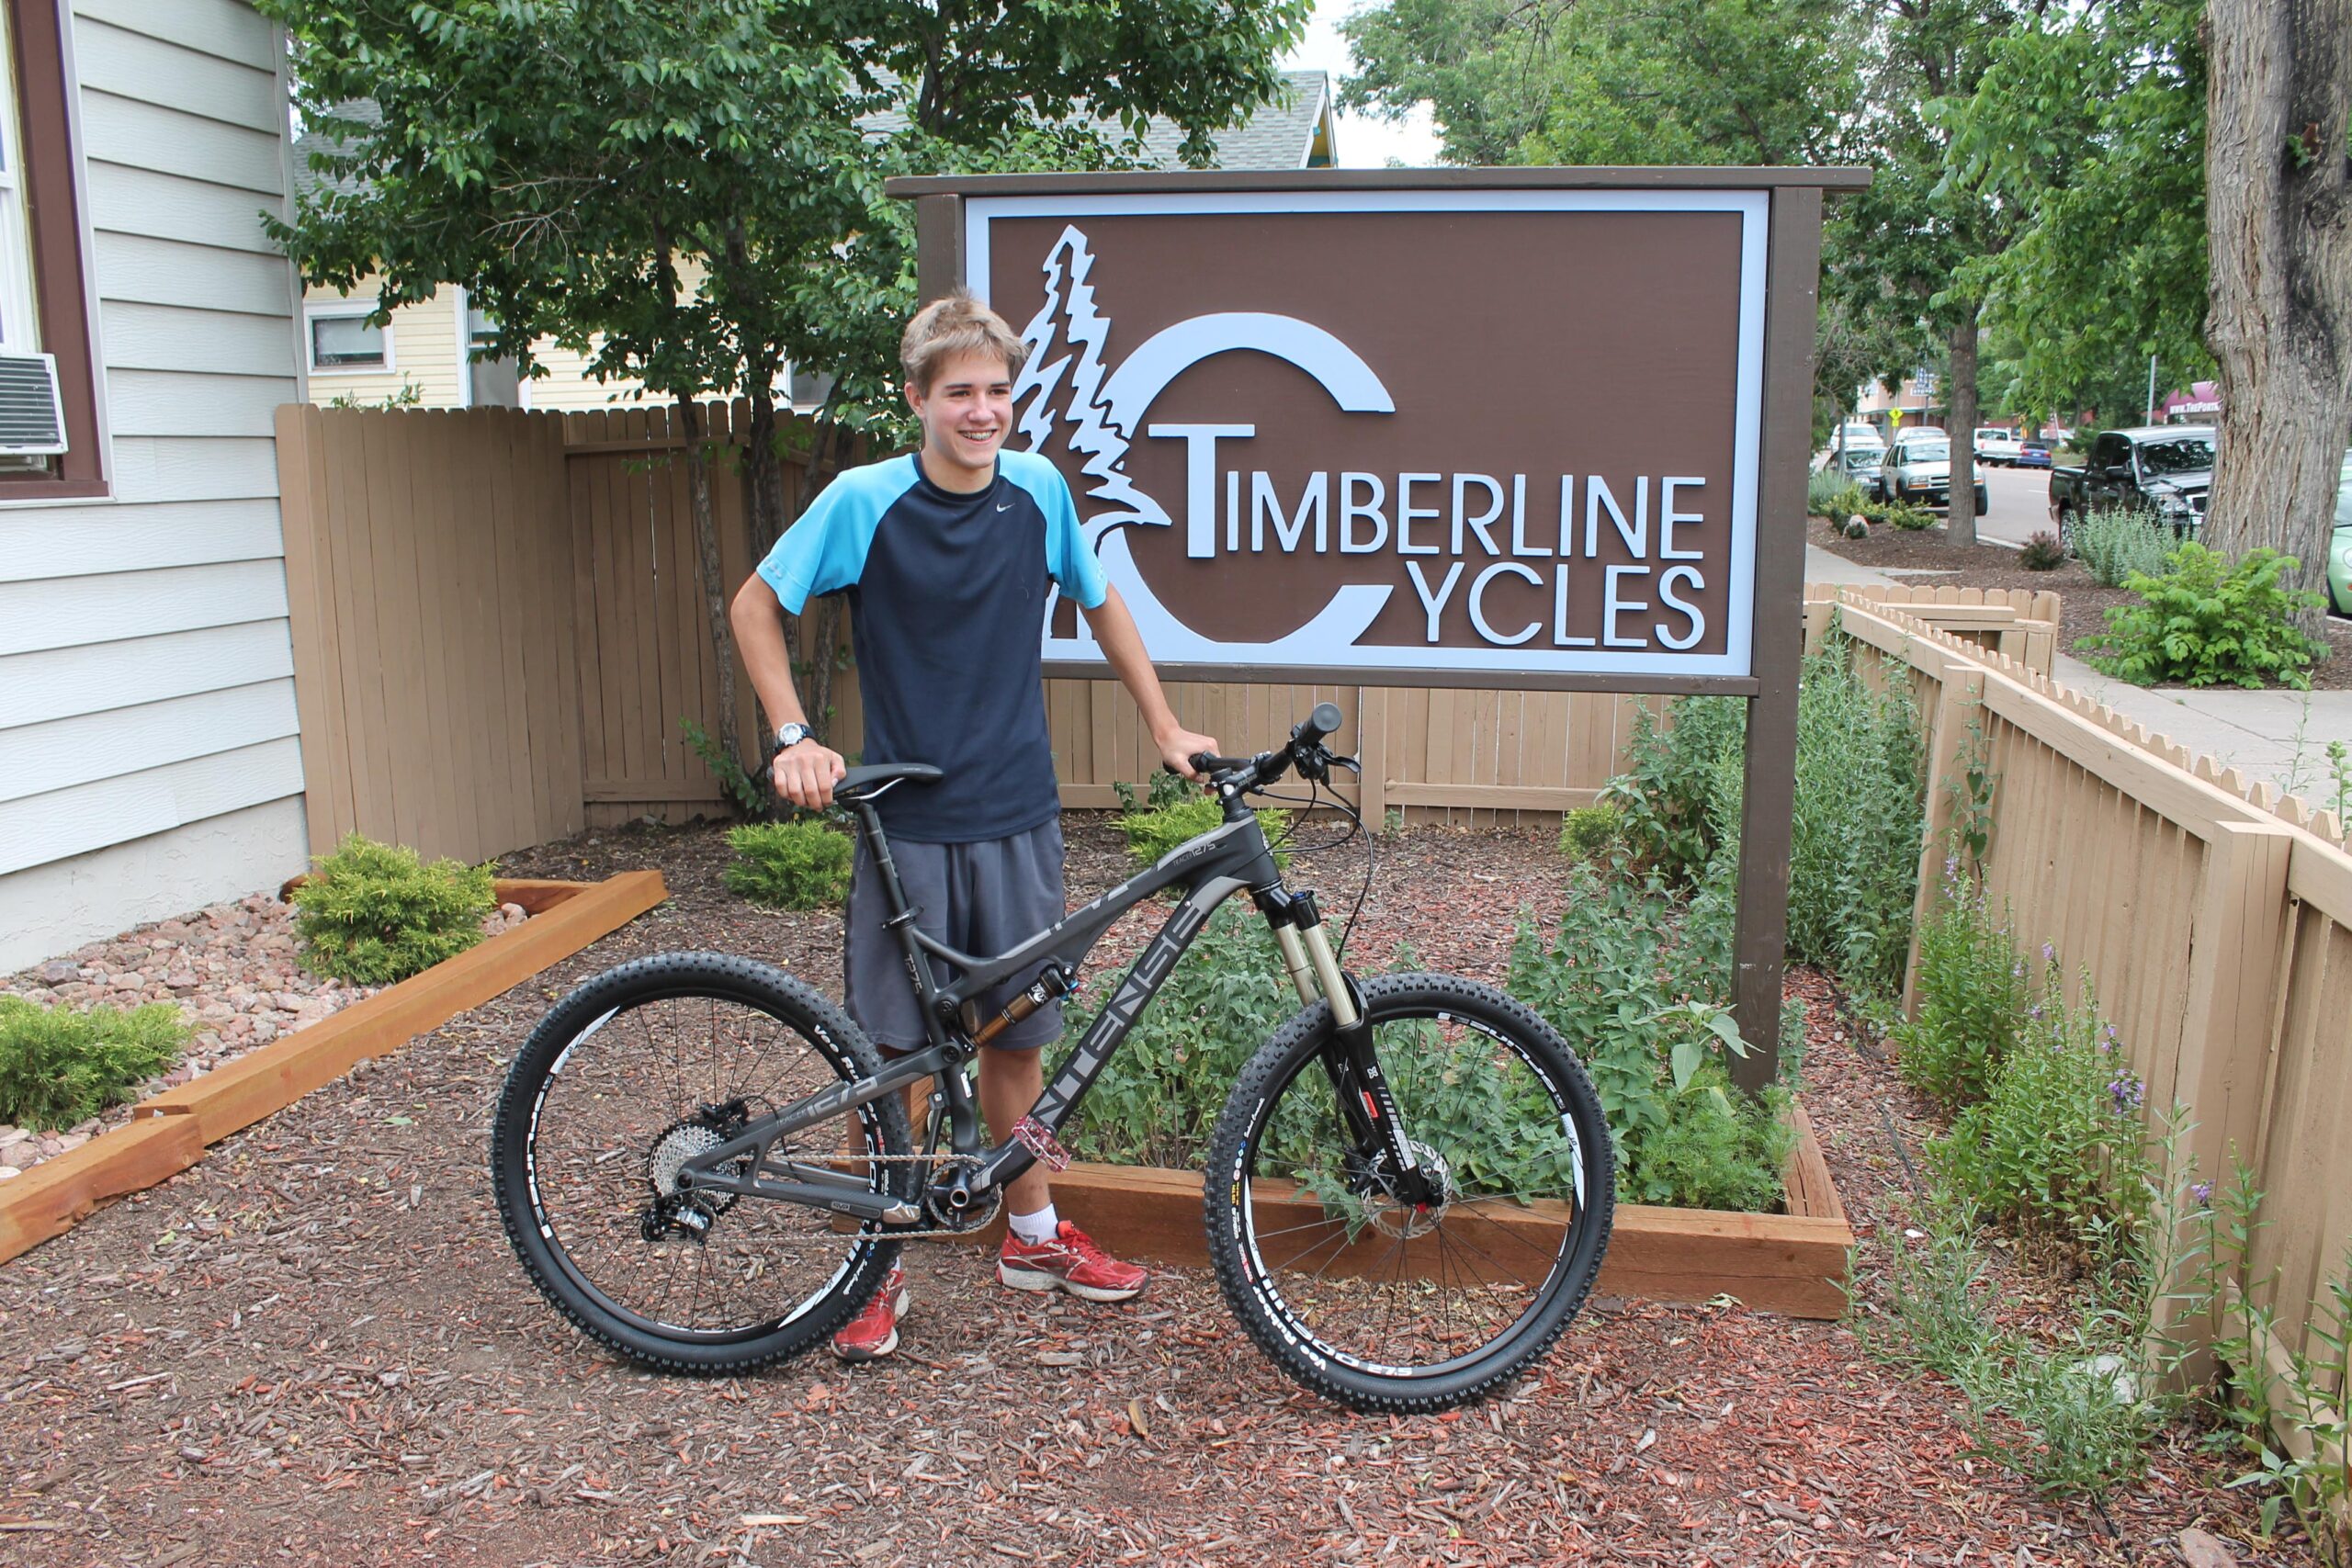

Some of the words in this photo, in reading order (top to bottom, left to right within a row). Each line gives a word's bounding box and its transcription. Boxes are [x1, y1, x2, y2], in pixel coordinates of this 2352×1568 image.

[1148, 423, 1707, 559] TIMBERLINE
[1023, 902, 1208, 1128] NTENSE
[1252, 1285, 1297, 1347] Rubber
[1299, 1343, 1327, 1372] Vee
[1365, 1362, 1413, 1377] 27.5
